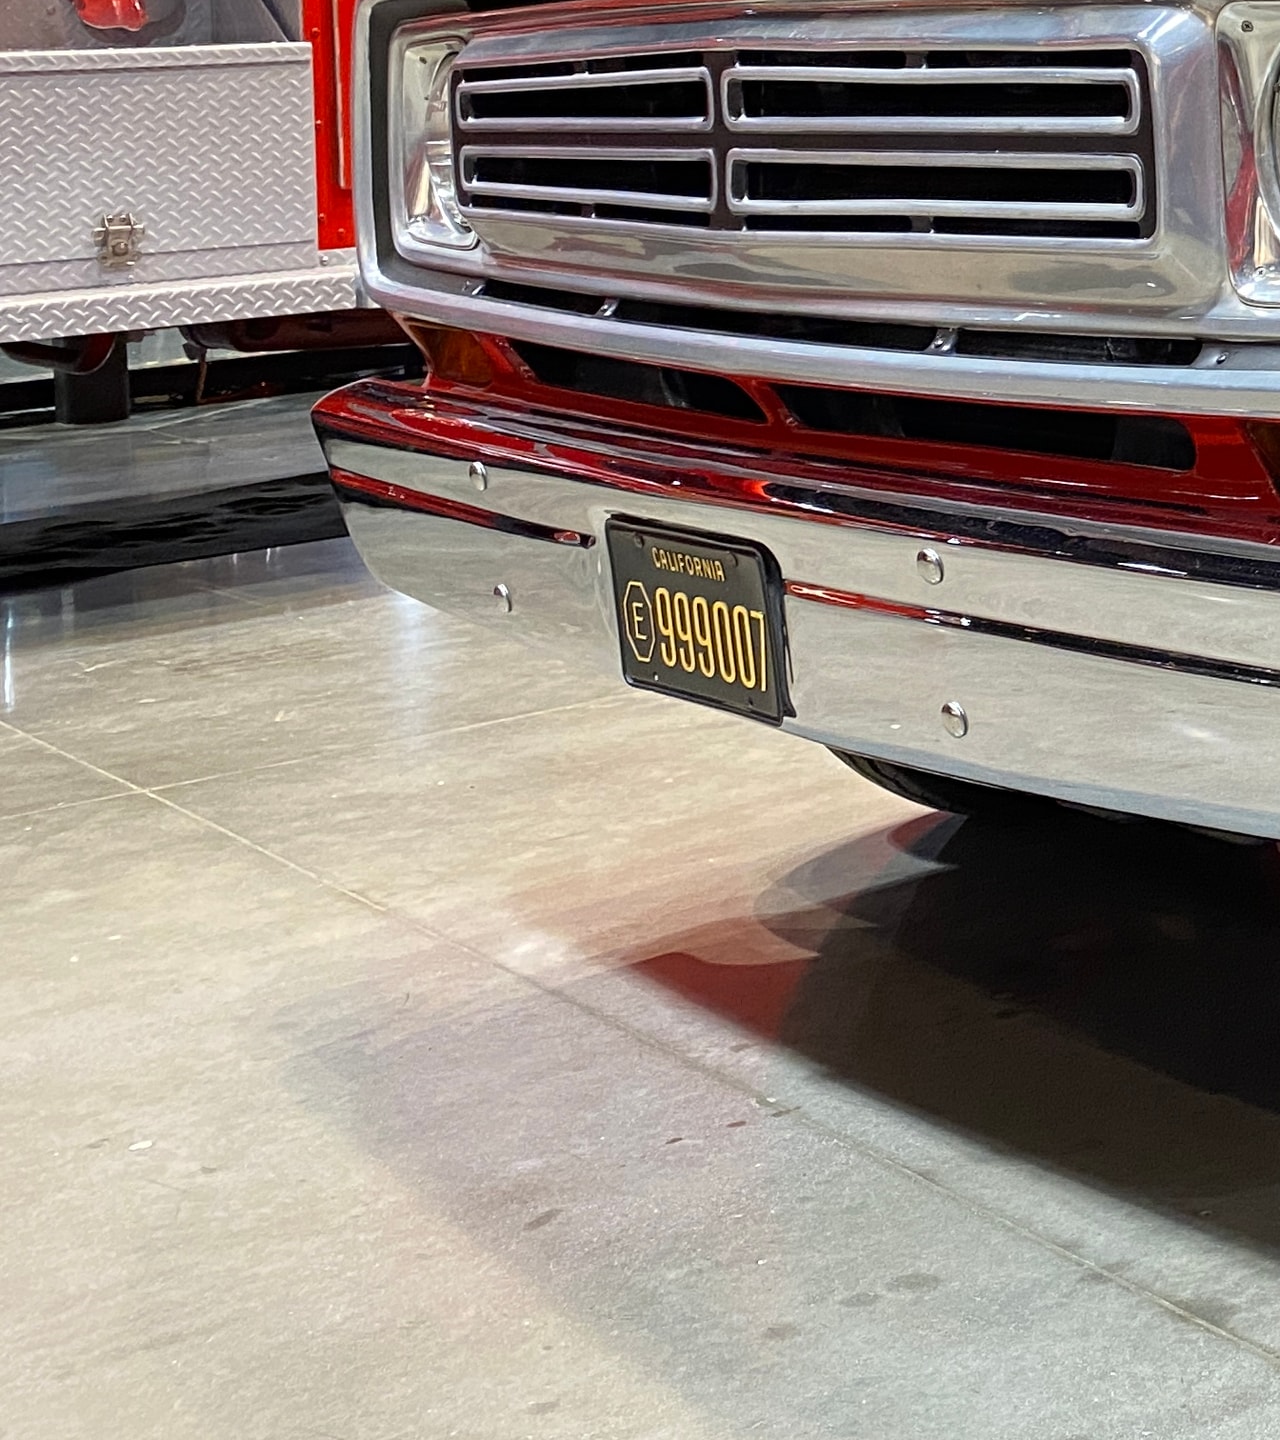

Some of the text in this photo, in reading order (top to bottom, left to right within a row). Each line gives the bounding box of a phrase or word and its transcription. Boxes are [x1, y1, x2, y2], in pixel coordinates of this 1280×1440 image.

[651, 546, 726, 582] CALIFORNIA
[632, 587, 766, 692] E 999007
